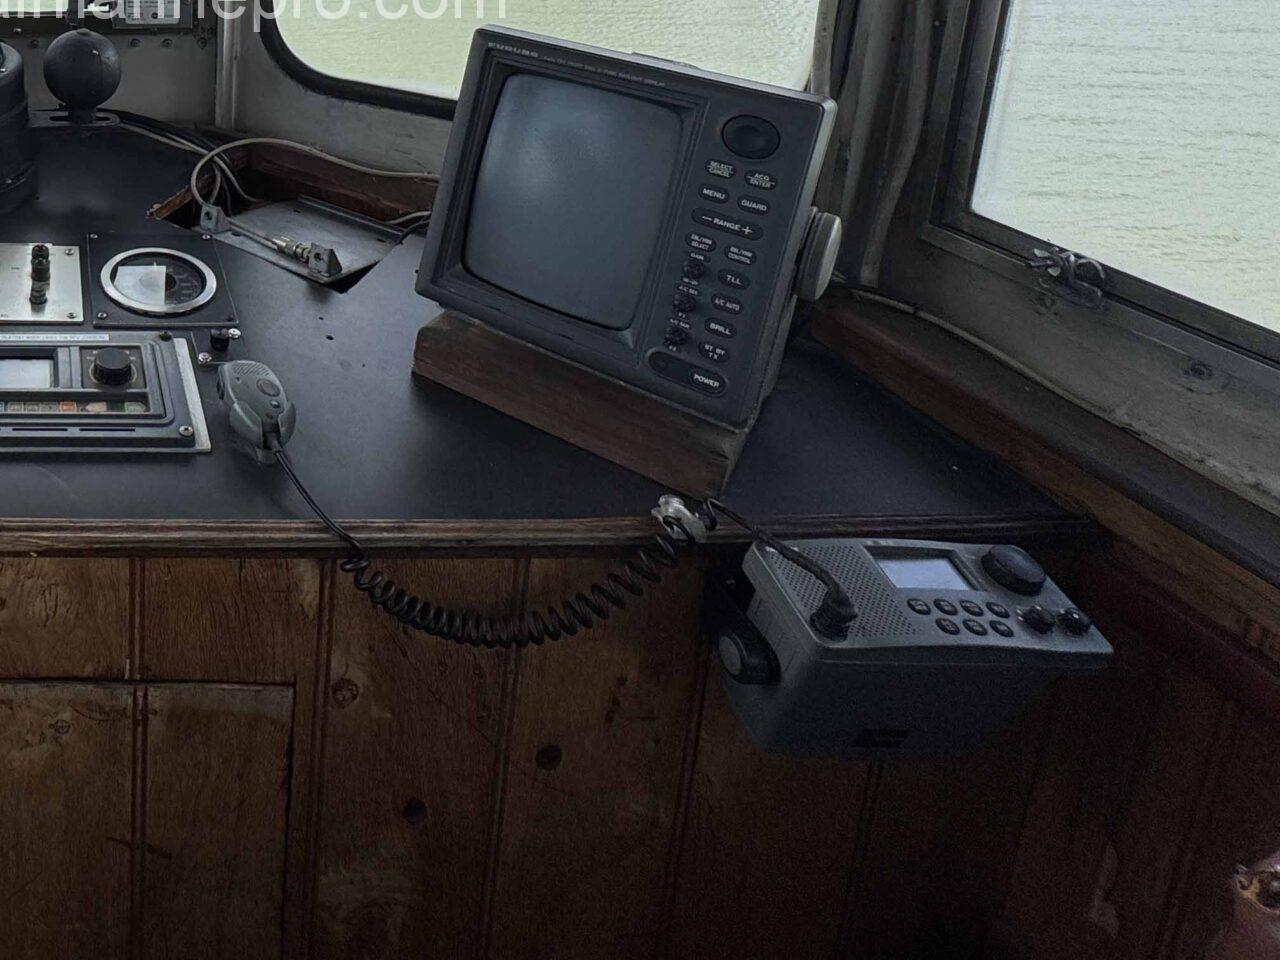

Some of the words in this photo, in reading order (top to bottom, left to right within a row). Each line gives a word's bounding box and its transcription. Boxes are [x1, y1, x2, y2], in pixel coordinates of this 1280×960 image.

[488, 42, 539, 58] FURUNO
[710, 161, 733, 170] SELECT
[749, 177, 771, 188] ENTER
[702, 188, 726, 200] MENU
[741, 199, 767, 211] GUARD
[713, 217, 741, 231] RANGE
[726, 274, 742, 285] TLL
[709, 322, 731, 335] BRILL
[694, 373, 720, 388] POWER
